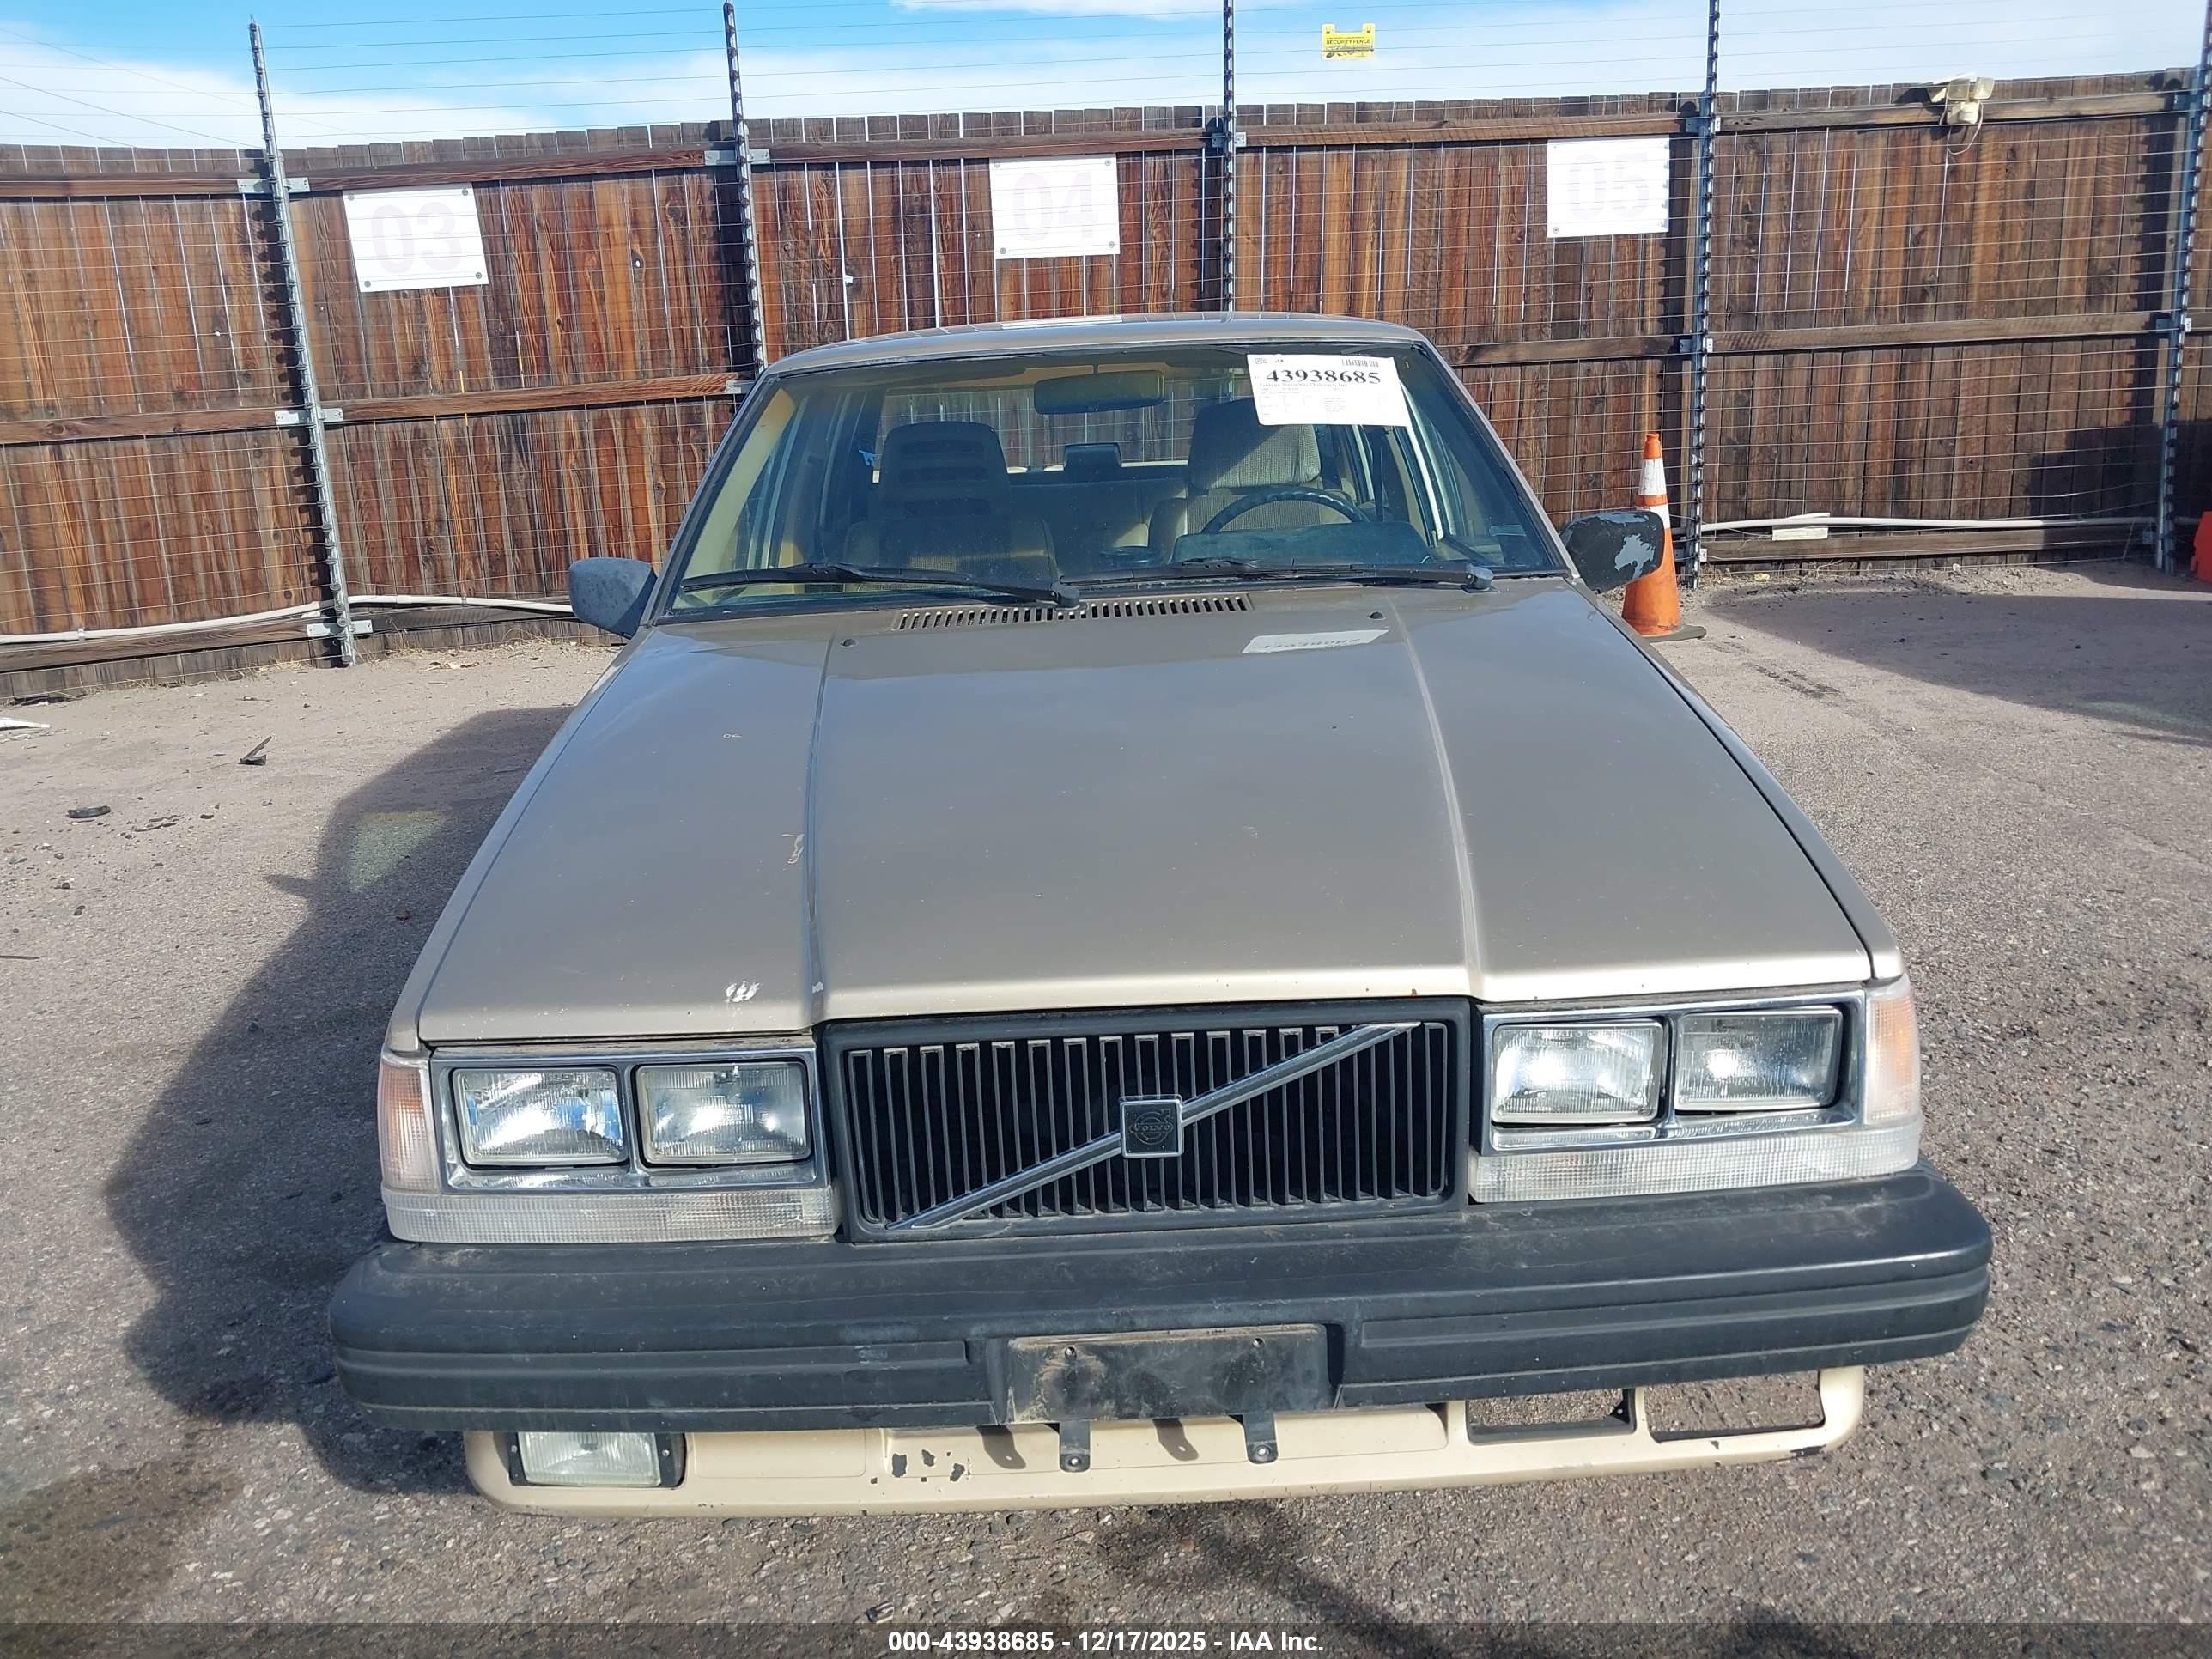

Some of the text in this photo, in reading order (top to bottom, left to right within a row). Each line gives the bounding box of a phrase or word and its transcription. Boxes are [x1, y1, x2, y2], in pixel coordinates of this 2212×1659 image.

[1013, 173, 1098, 241] 04
[1568, 153, 1649, 220] 05
[371, 202, 462, 274] 03
[1266, 369, 1381, 384] 43938685
[1134, 1122, 1171, 1132] VOLVO
